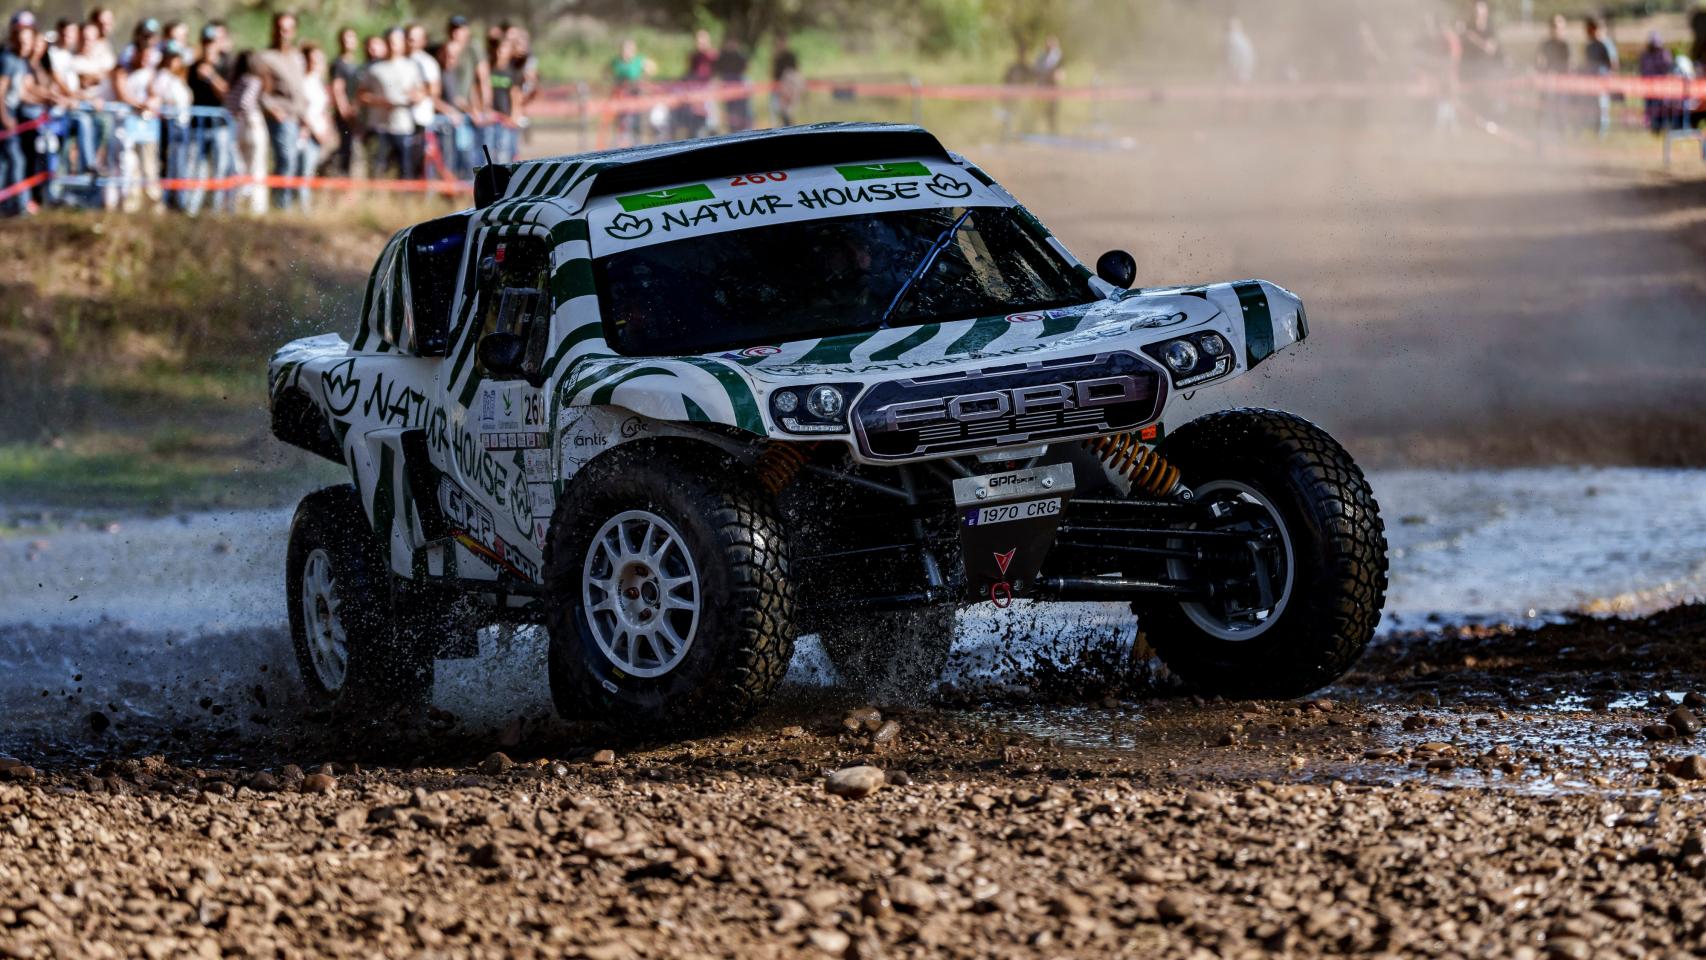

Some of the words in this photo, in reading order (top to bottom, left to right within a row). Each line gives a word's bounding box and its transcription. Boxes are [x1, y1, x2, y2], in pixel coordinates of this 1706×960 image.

[730, 170, 788, 187] 260
[661, 195, 793, 232] NATUR
[798, 181, 920, 209] HOUSE
[525, 393, 545, 425] 260
[886, 376, 1136, 431] FORD
[364, 372, 450, 452] NATUR
[452, 423, 507, 505] HOUSE
[989, 475, 1017, 487] GPR
[449, 489, 496, 553] GPR
[983, 506, 1018, 523] 1970
[1028, 501, 1056, 517] CRG
